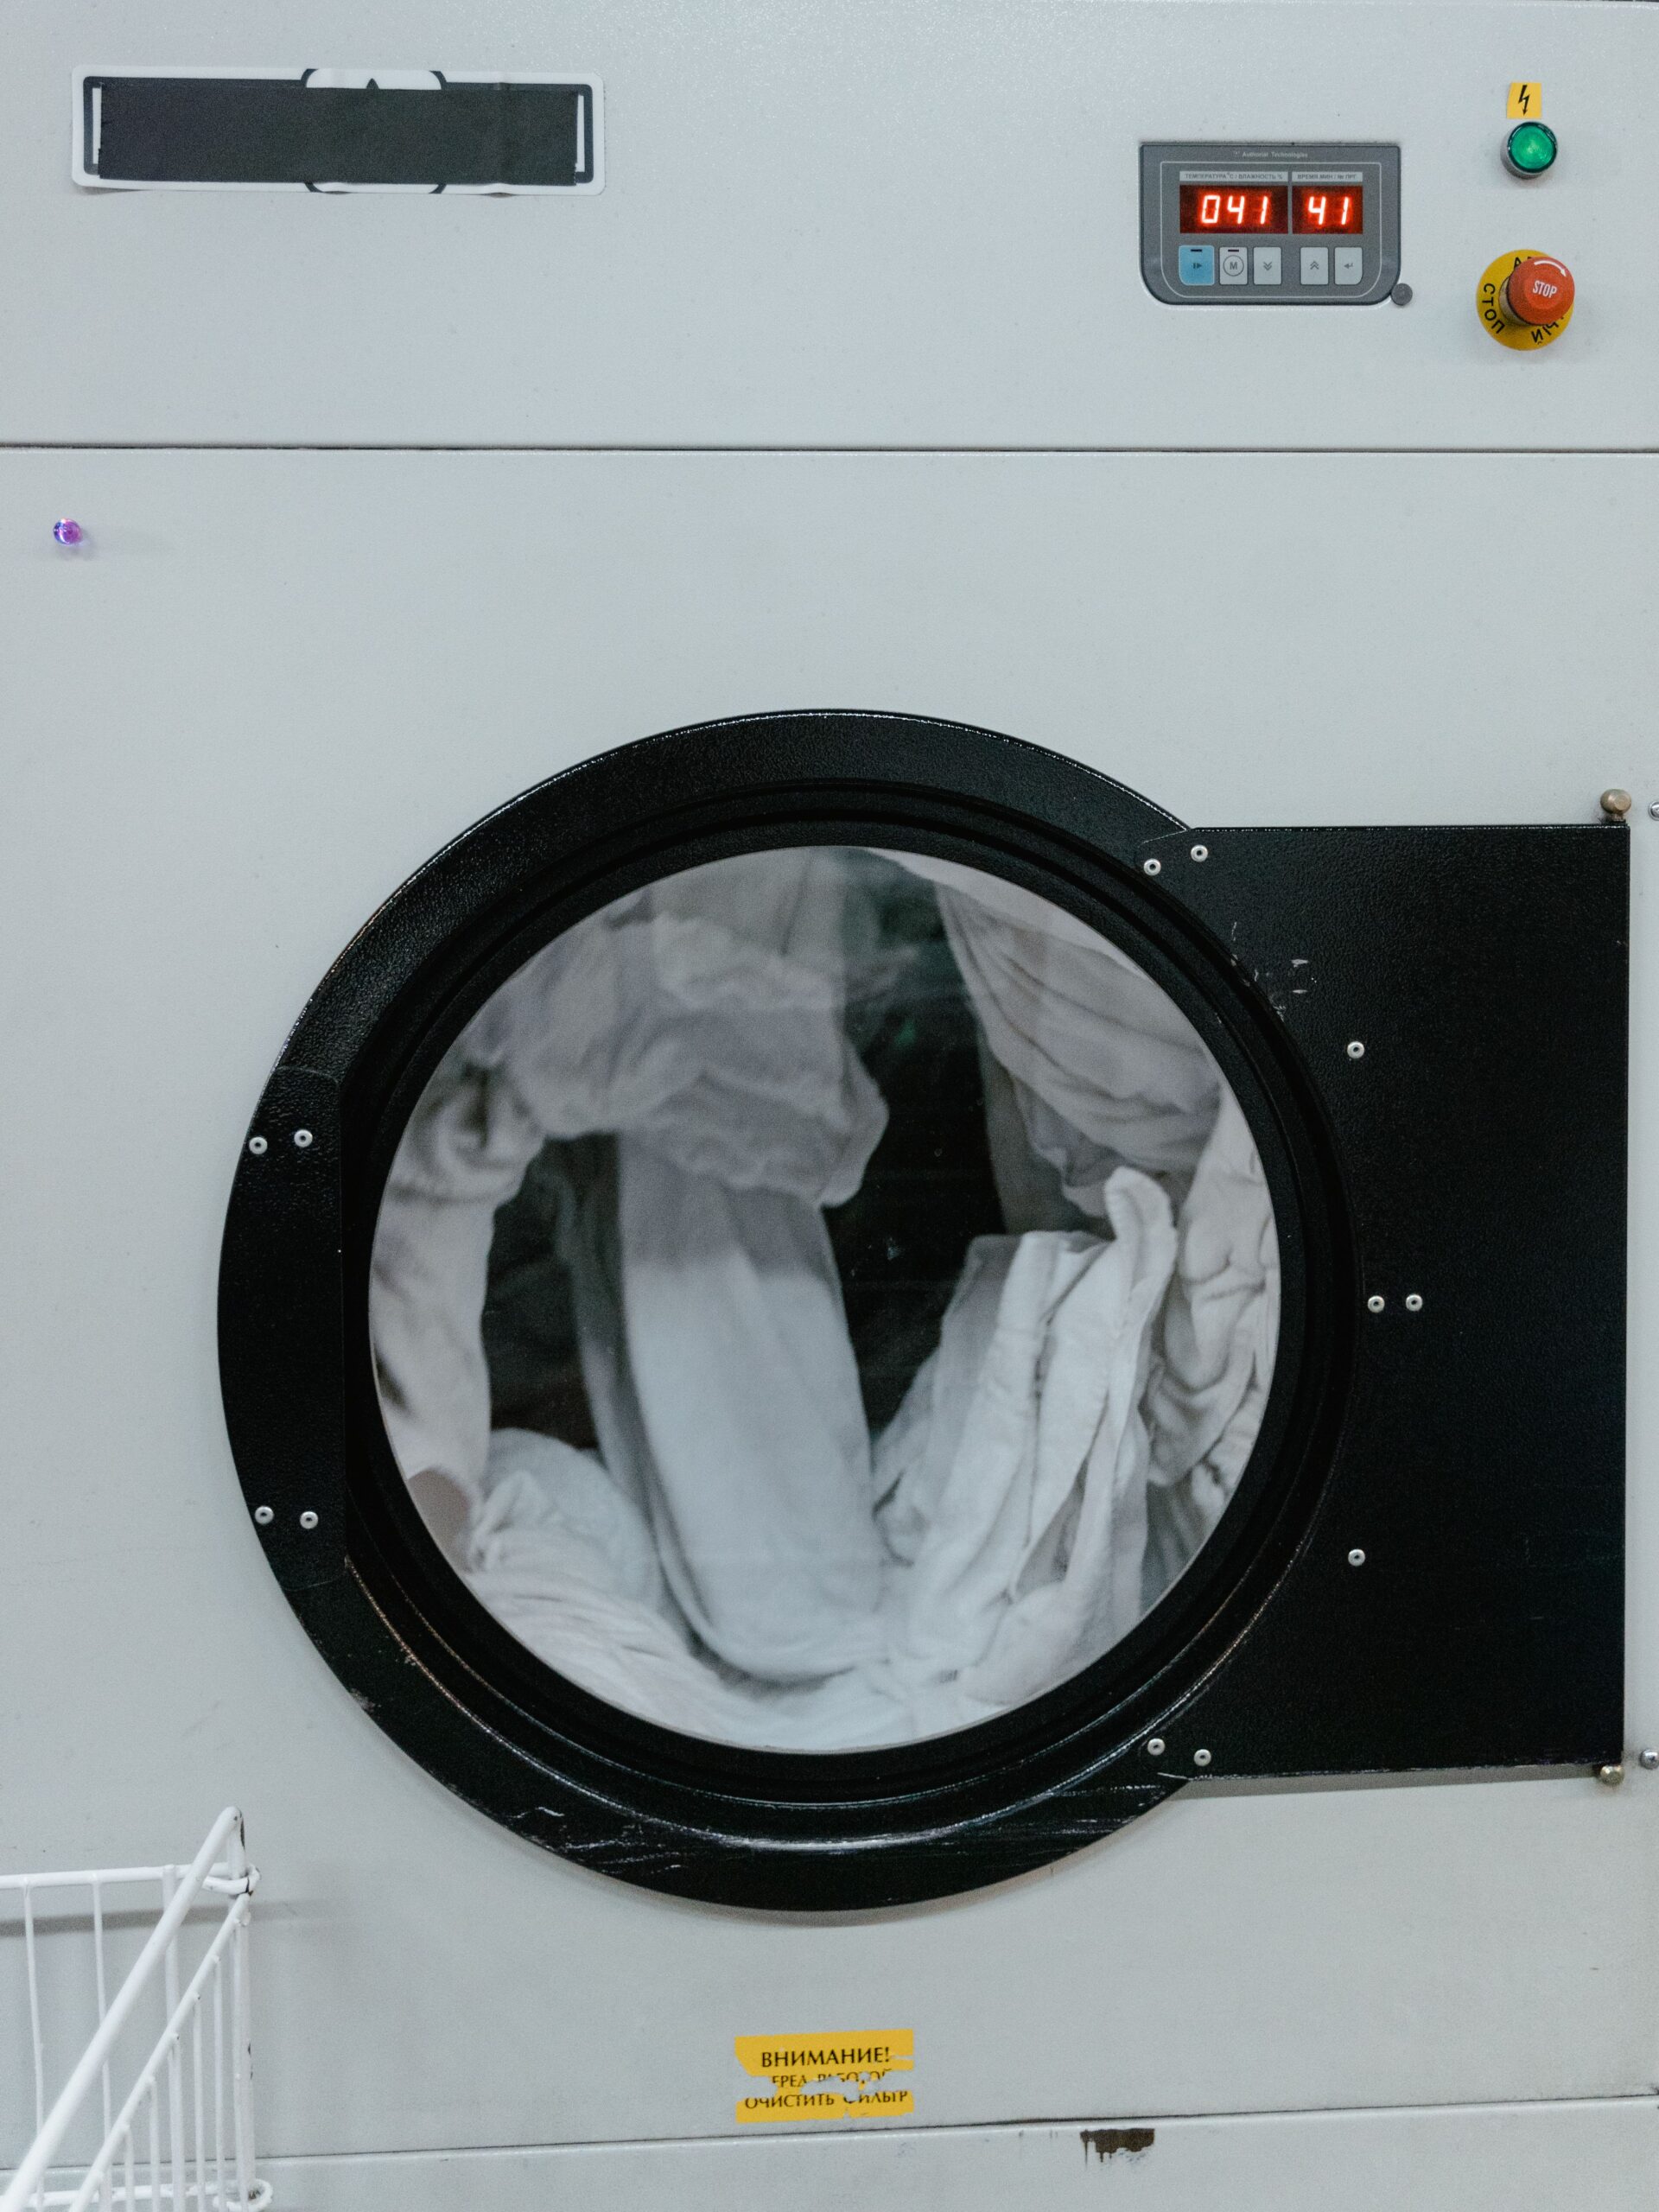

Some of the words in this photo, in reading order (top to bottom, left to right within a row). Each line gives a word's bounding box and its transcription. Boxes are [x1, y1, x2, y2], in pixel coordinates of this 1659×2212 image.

[1200, 194, 1268, 225] 041
[1307, 195, 1351, 226] 41
[1533, 280, 1558, 298] STOP
[1482, 283, 1505, 334] СТОП
[761, 2046, 891, 2068] ВНИМАНИЕ!
[745, 2094, 835, 2109] ОЧИСТИТЬ
